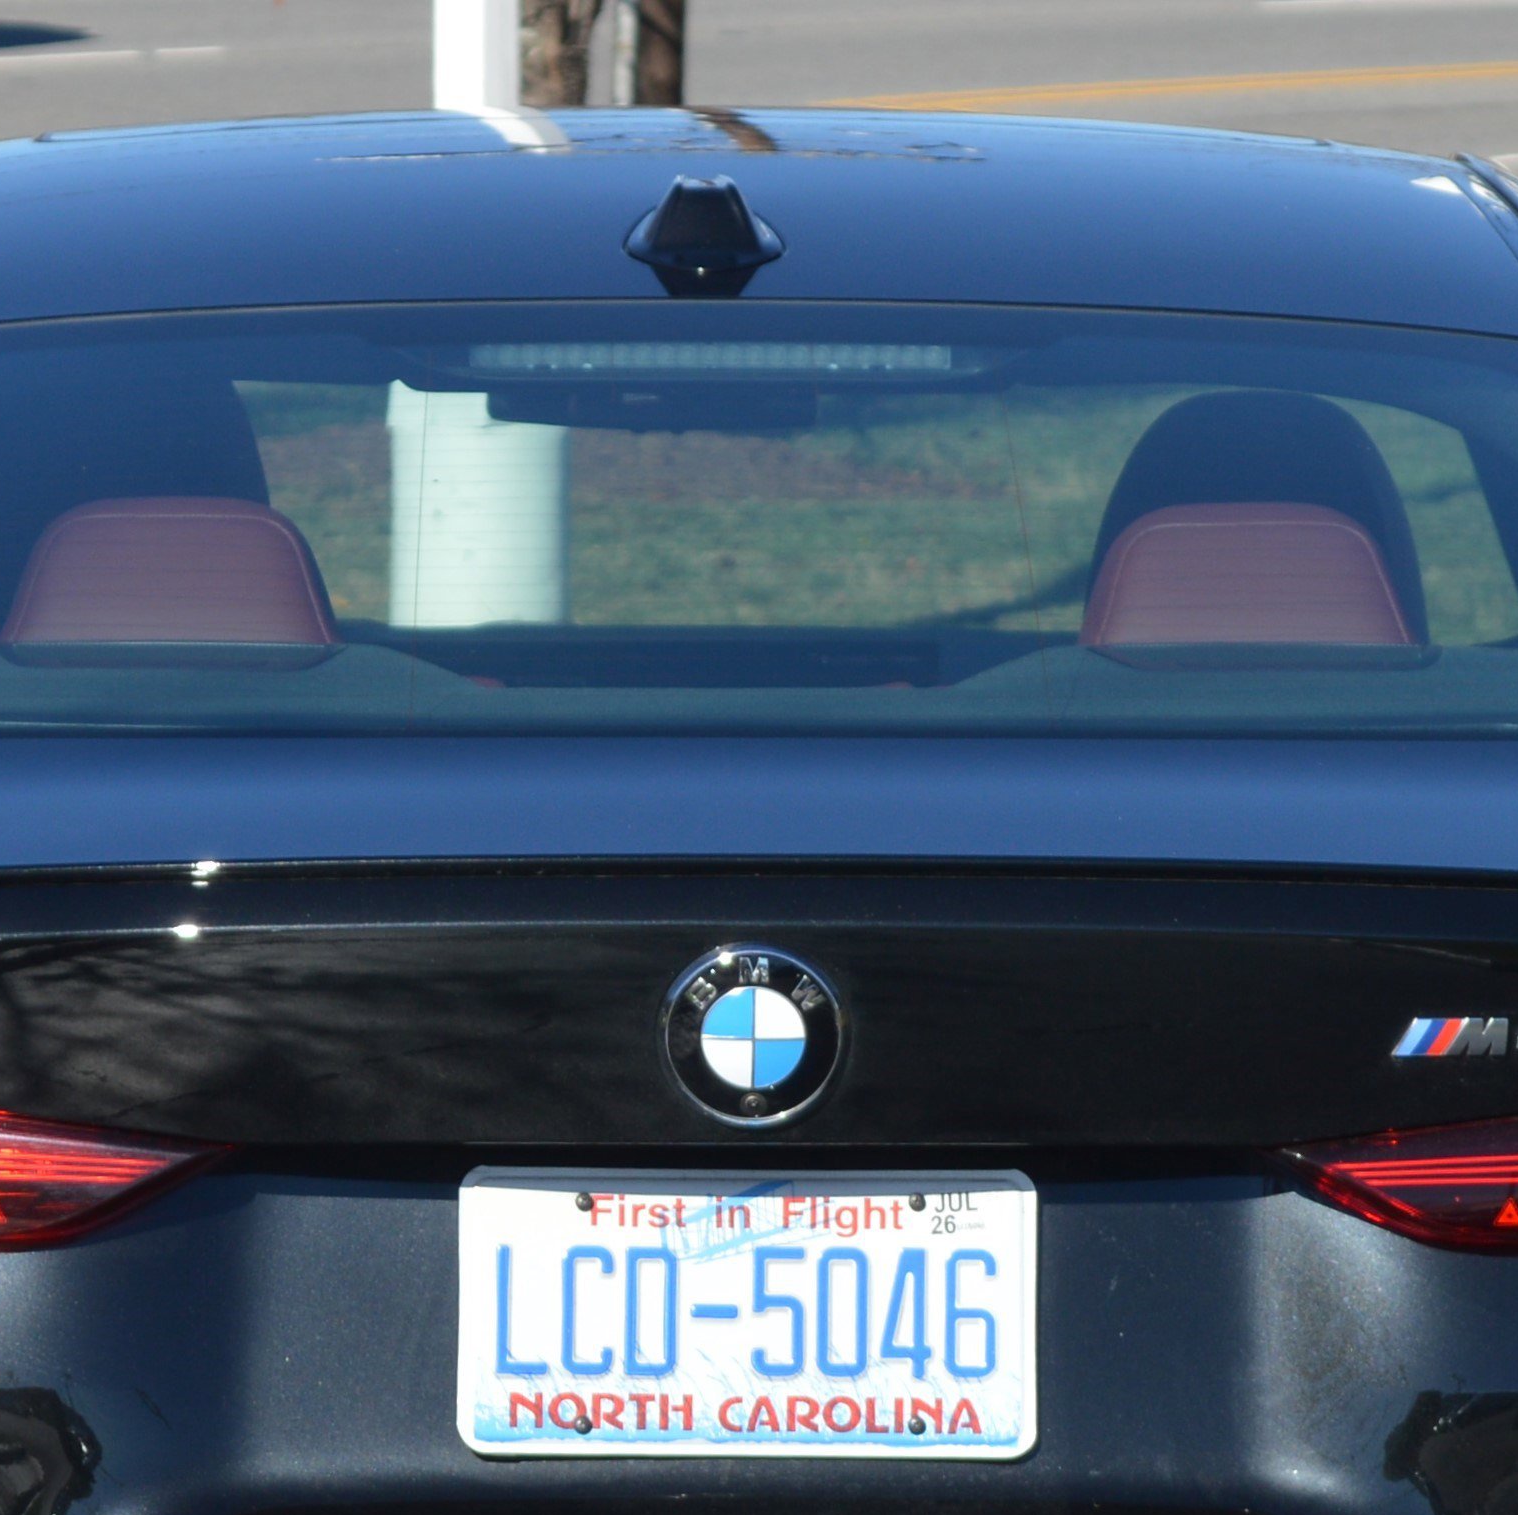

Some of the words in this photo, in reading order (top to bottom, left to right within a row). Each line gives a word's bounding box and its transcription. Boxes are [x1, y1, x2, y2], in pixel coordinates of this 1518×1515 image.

[685, 956, 826, 1011] BMW
[588, 1193, 687, 1229] First
[714, 1195, 752, 1230] in
[782, 1196, 904, 1238] Flight
[934, 1191, 979, 1213] JUL
[930, 1214, 957, 1235] 26
[495, 1243, 997, 1380] LCD-5046
[508, 1391, 694, 1431] NORTH
[717, 1395, 983, 1435] CAROLINA
